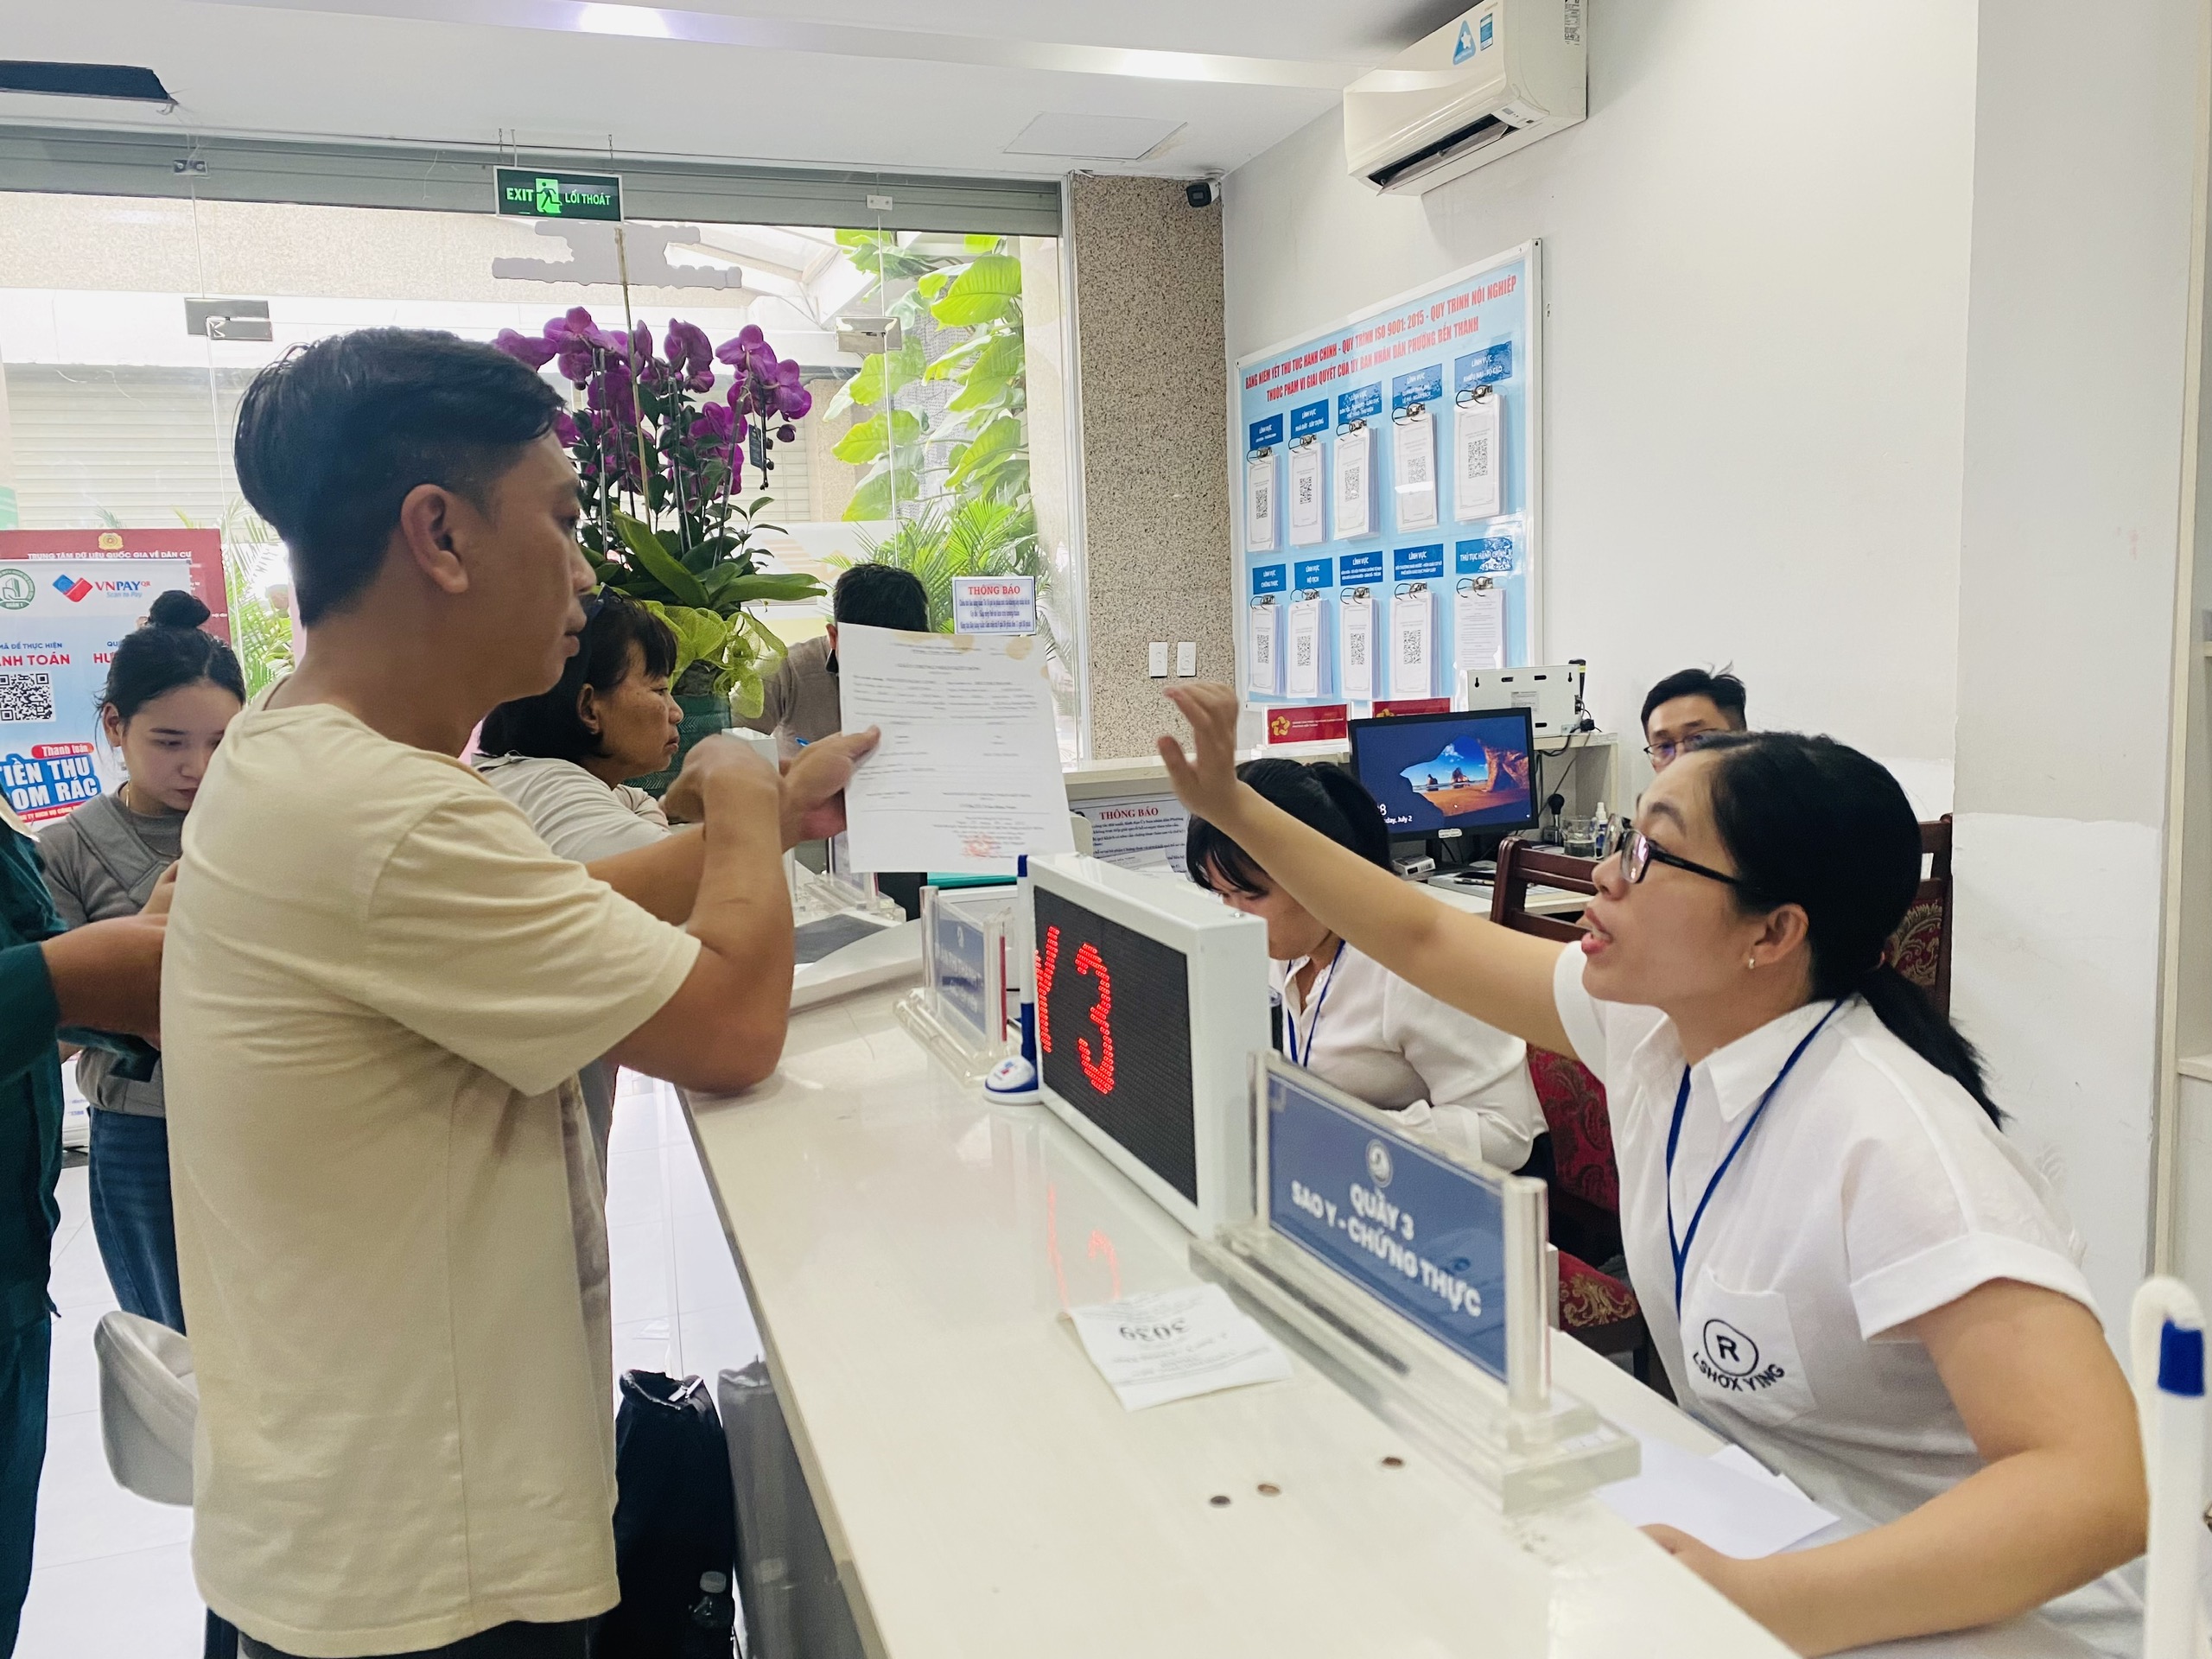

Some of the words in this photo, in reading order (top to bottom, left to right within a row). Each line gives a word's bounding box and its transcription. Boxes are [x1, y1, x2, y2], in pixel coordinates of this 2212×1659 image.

[505, 188, 535, 201] EXIT
[564, 188, 580, 204] LỐI
[582, 192, 611, 206] THOÁT
[1319, 342, 1338, 361] CHÍNH
[1342, 335, 1354, 354] QUY
[1355, 327, 1374, 347] TRÌNH
[1375, 324, 1386, 340] ISO
[1407, 309, 1425, 331] 2015
[1430, 301, 1446, 322] QUY
[1446, 293, 1470, 315] TRÌNH
[1471, 285, 1485, 308] NỘI
[1487, 274, 1517, 301] NGHIỆP
[1300, 377, 1306, 391] VI
[1319, 362, 1337, 385] QUYẾT
[1438, 321, 1452, 344] BẾN
[1453, 315, 1479, 339] THÀNH
[105, 550, 130, 560] QUỐC
[95, 581, 141, 591] VNPAY
[968, 583, 1000, 595] THÔNG
[1002, 582, 1020, 595] BÁO
[22, 642, 43, 651] THỰC
[45, 641, 62, 650] HIỆN
[27, 651, 71, 665] TOÁN
[41, 745, 71, 757] Thanh
[47, 756, 91, 780] THU
[11, 785, 50, 810] OM
[54, 777, 99, 803] RÁC
[1099, 808, 1135, 821] THÔNG
[1138, 805, 1159, 817] BÁO
[1075, 943, 1115, 1095] 3
[1349, 1182, 1401, 1230] QUẦY
[1401, 1214, 1415, 1241] 3
[1291, 1180, 1325, 1219] SAO
[1323, 1204, 1338, 1228] Y
[1347, 1217, 1418, 1278] CHỨNG
[1417, 1259, 1483, 1318] THỰC
[1716, 1334, 1740, 1363] R
